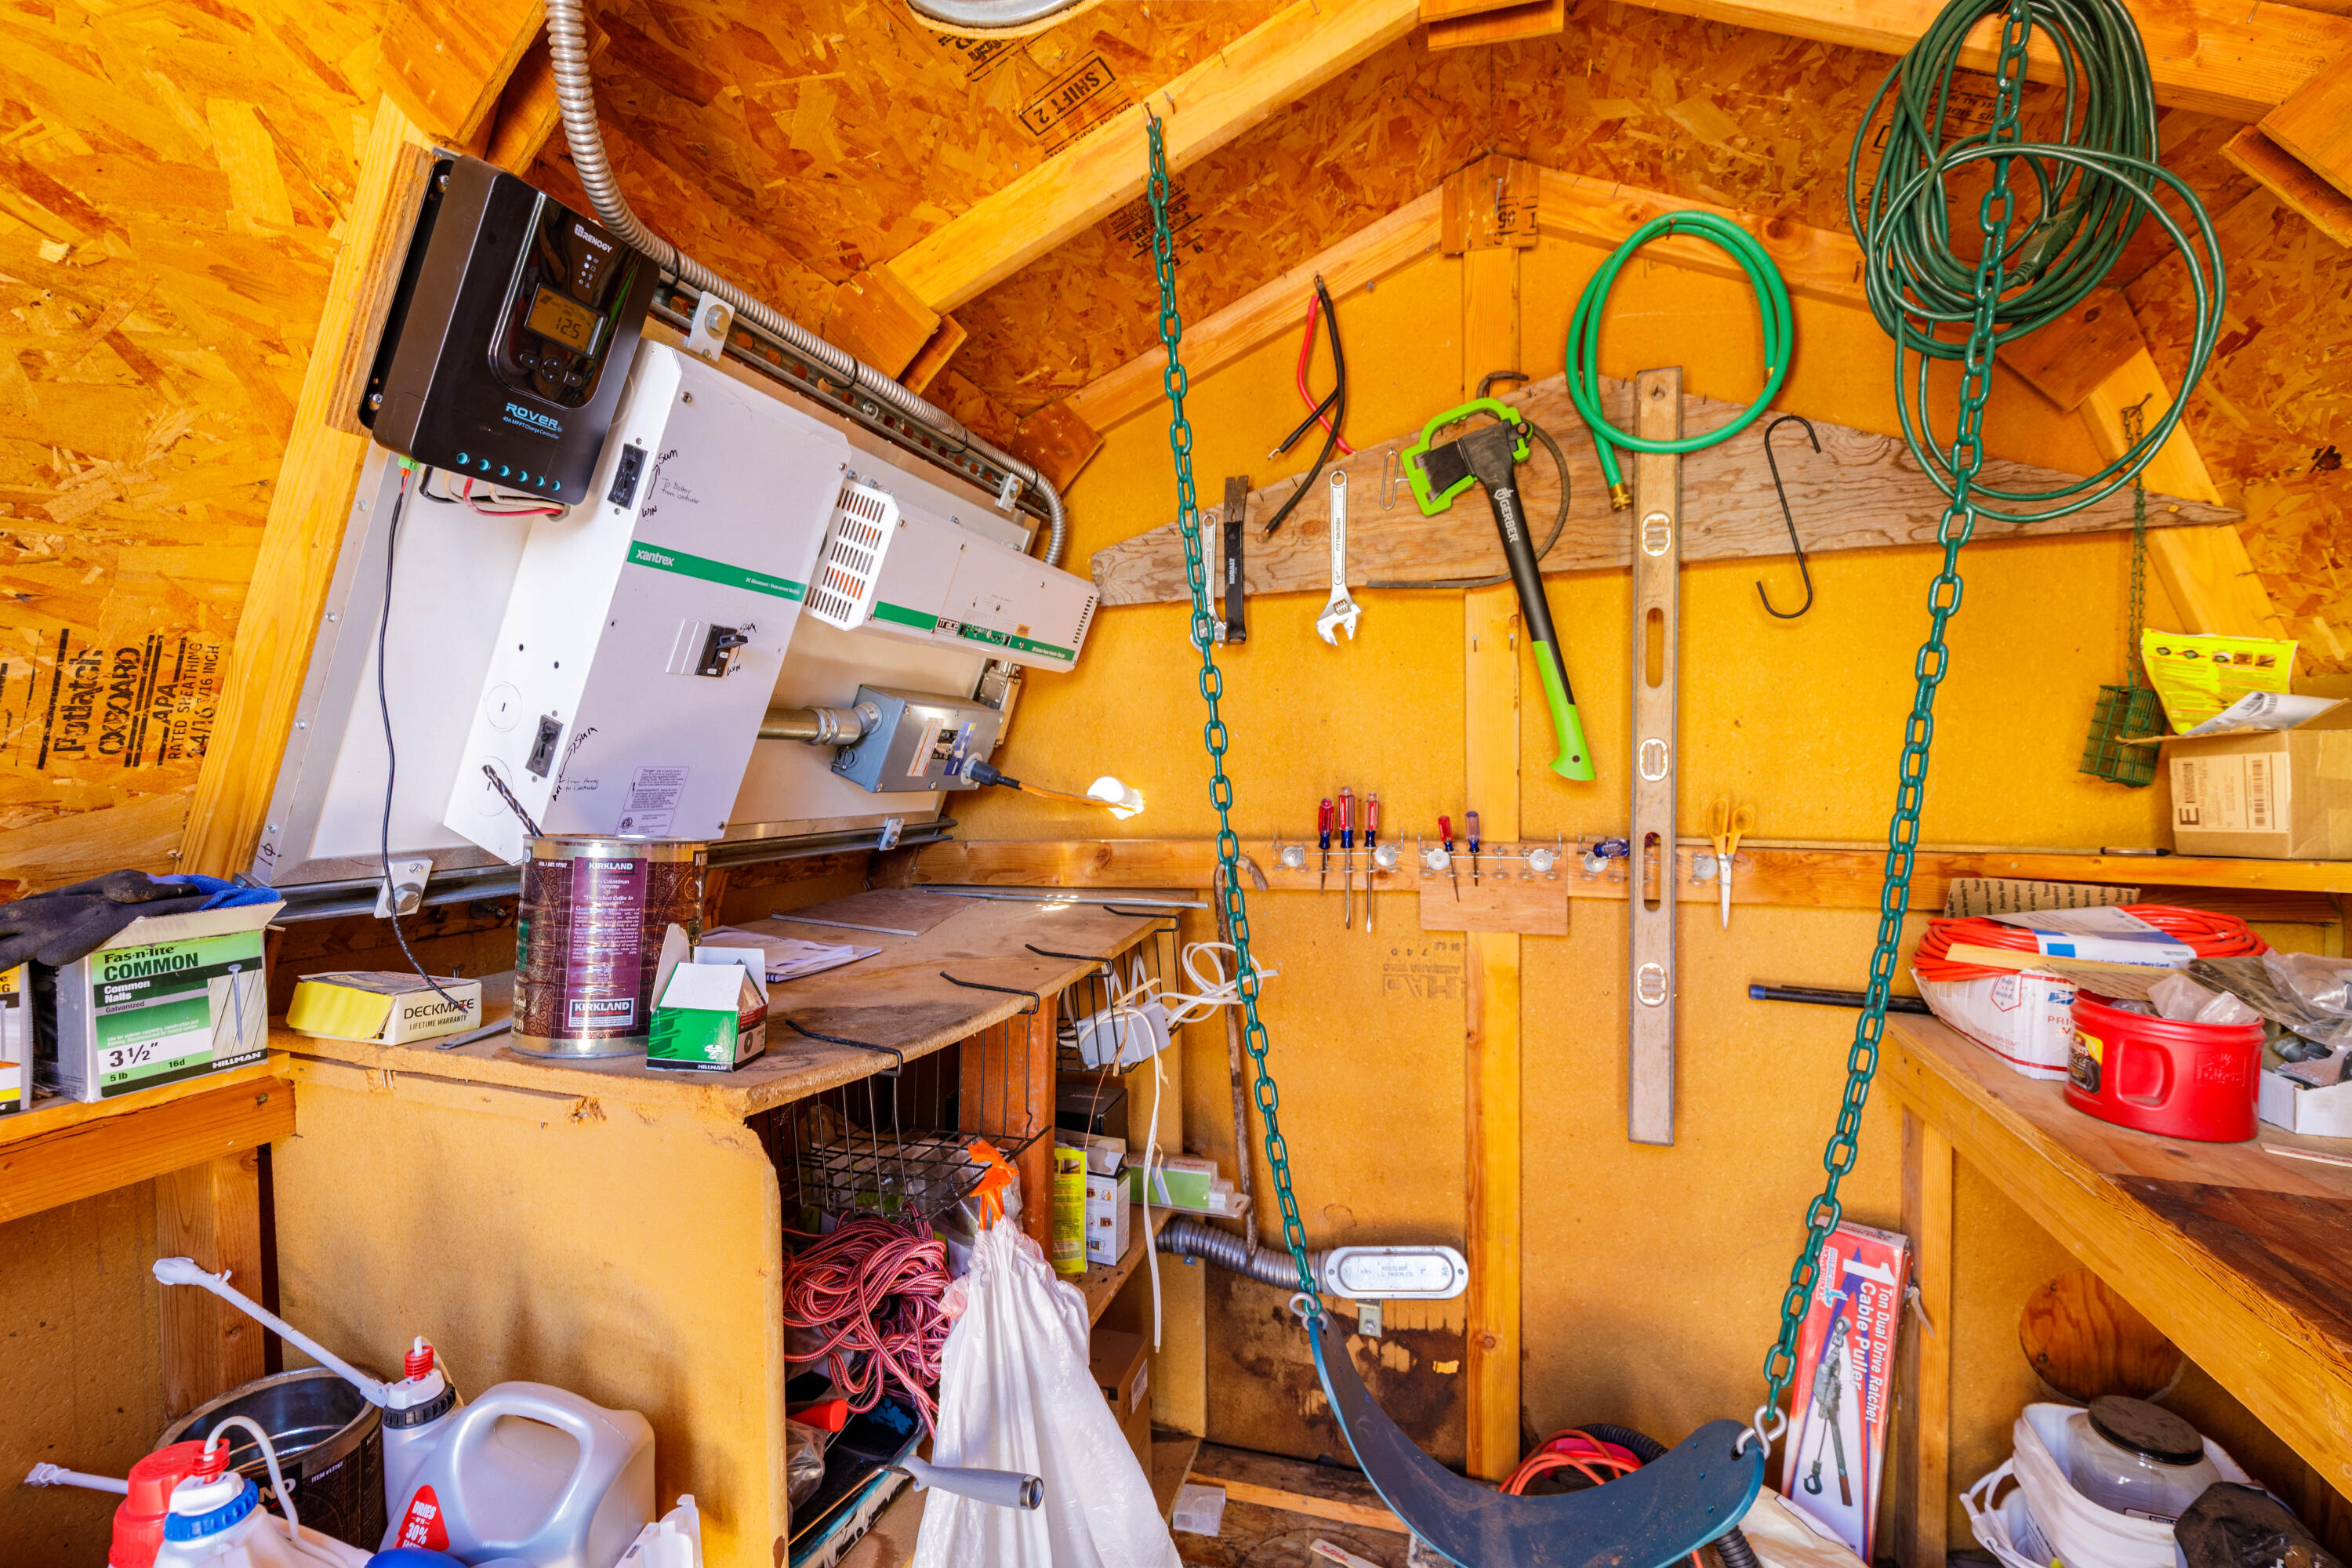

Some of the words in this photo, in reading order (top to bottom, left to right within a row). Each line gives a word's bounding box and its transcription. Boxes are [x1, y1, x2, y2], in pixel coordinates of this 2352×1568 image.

[1050, 71, 1101, 115] SHIFT
[1033, 107, 1051, 125] 2
[582, 231, 613, 252] RENOGY
[505, 401, 559, 430] ROVER
[512, 418, 526, 429] MPPT
[524, 423, 540, 434] Charge
[539, 427, 561, 440] Controller
[1499, 499, 1519, 543] GERBER
[636, 549, 675, 567] xantrex
[202, 644, 220, 673] INCH
[177, 642, 203, 715] SHEATHING
[53, 648, 104, 753] Potlatch
[97, 647, 141, 756] OXBOARD
[152, 684, 179, 727] APA
[167, 719, 188, 760] RATED
[2179, 807, 2200, 826] E
[589, 862, 633, 870] KIRKLAND
[104, 953, 198, 982] COMMON
[103, 980, 151, 994] Common
[104, 992, 132, 1004] Nails
[105, 1000, 145, 1014] Galvanized
[574, 1001, 630, 1012] KIRKLAND
[408, 1019, 437, 1031] LIFETIME
[437, 1014, 468, 1027] WARRANTY
[109, 1050, 124, 1069] 3
[168, 1058, 186, 1069] 16d
[212, 1051, 262, 1069] HILLMAN
[110, 1074, 118, 1083] 5
[118, 1073, 129, 1081] lb
[1842, 1258, 1896, 1287] 1
[1857, 1282, 1877, 1331] Cable
[1876, 1287, 1893, 1308] Ton
[1875, 1309, 1891, 1342] Dual
[1850, 1336, 1871, 1391] Puller
[1871, 1339, 1888, 1374] Drive
[1865, 1373, 1884, 1424] Ratchet
[310, 1471, 326, 1484] ITEM
[412, 1500, 437, 1521] DRIES
[405, 1522, 430, 1545] 30%
